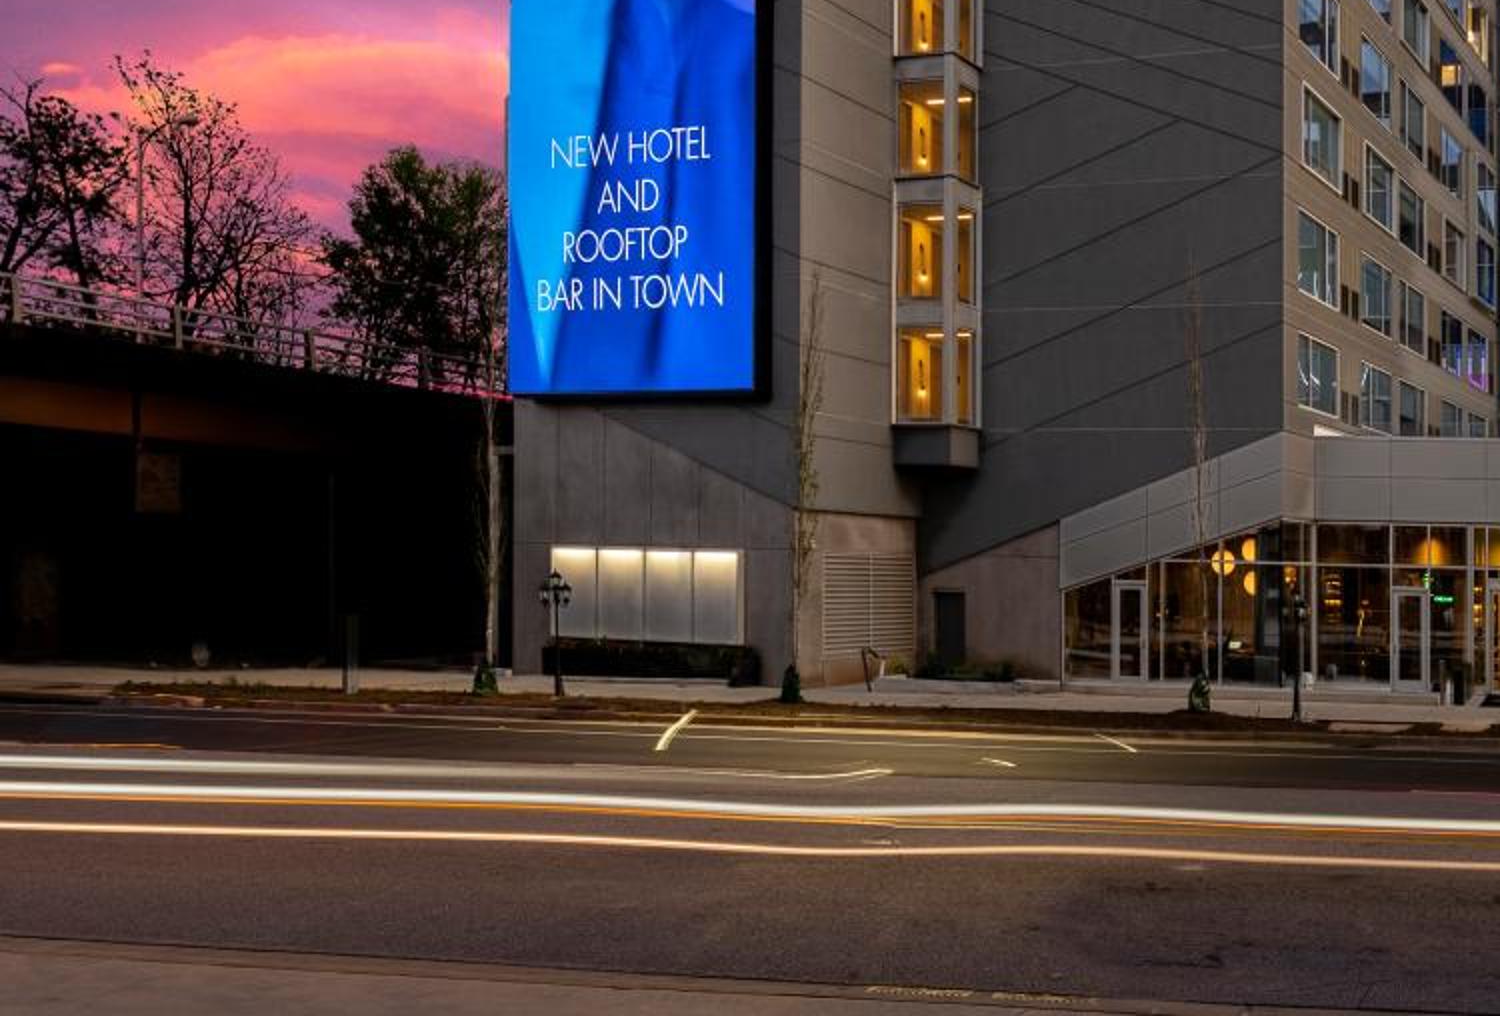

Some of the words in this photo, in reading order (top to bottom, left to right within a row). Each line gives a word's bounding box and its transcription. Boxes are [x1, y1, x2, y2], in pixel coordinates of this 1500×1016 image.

[551, 131, 619, 169] NEW
[628, 125, 711, 165] HOTEL
[597, 179, 660, 215] AND
[562, 224, 688, 264] ROOFTOP
[537, 278, 584, 312] BAR
[592, 276, 622, 311] IN
[629, 270, 724, 310] TOWN
